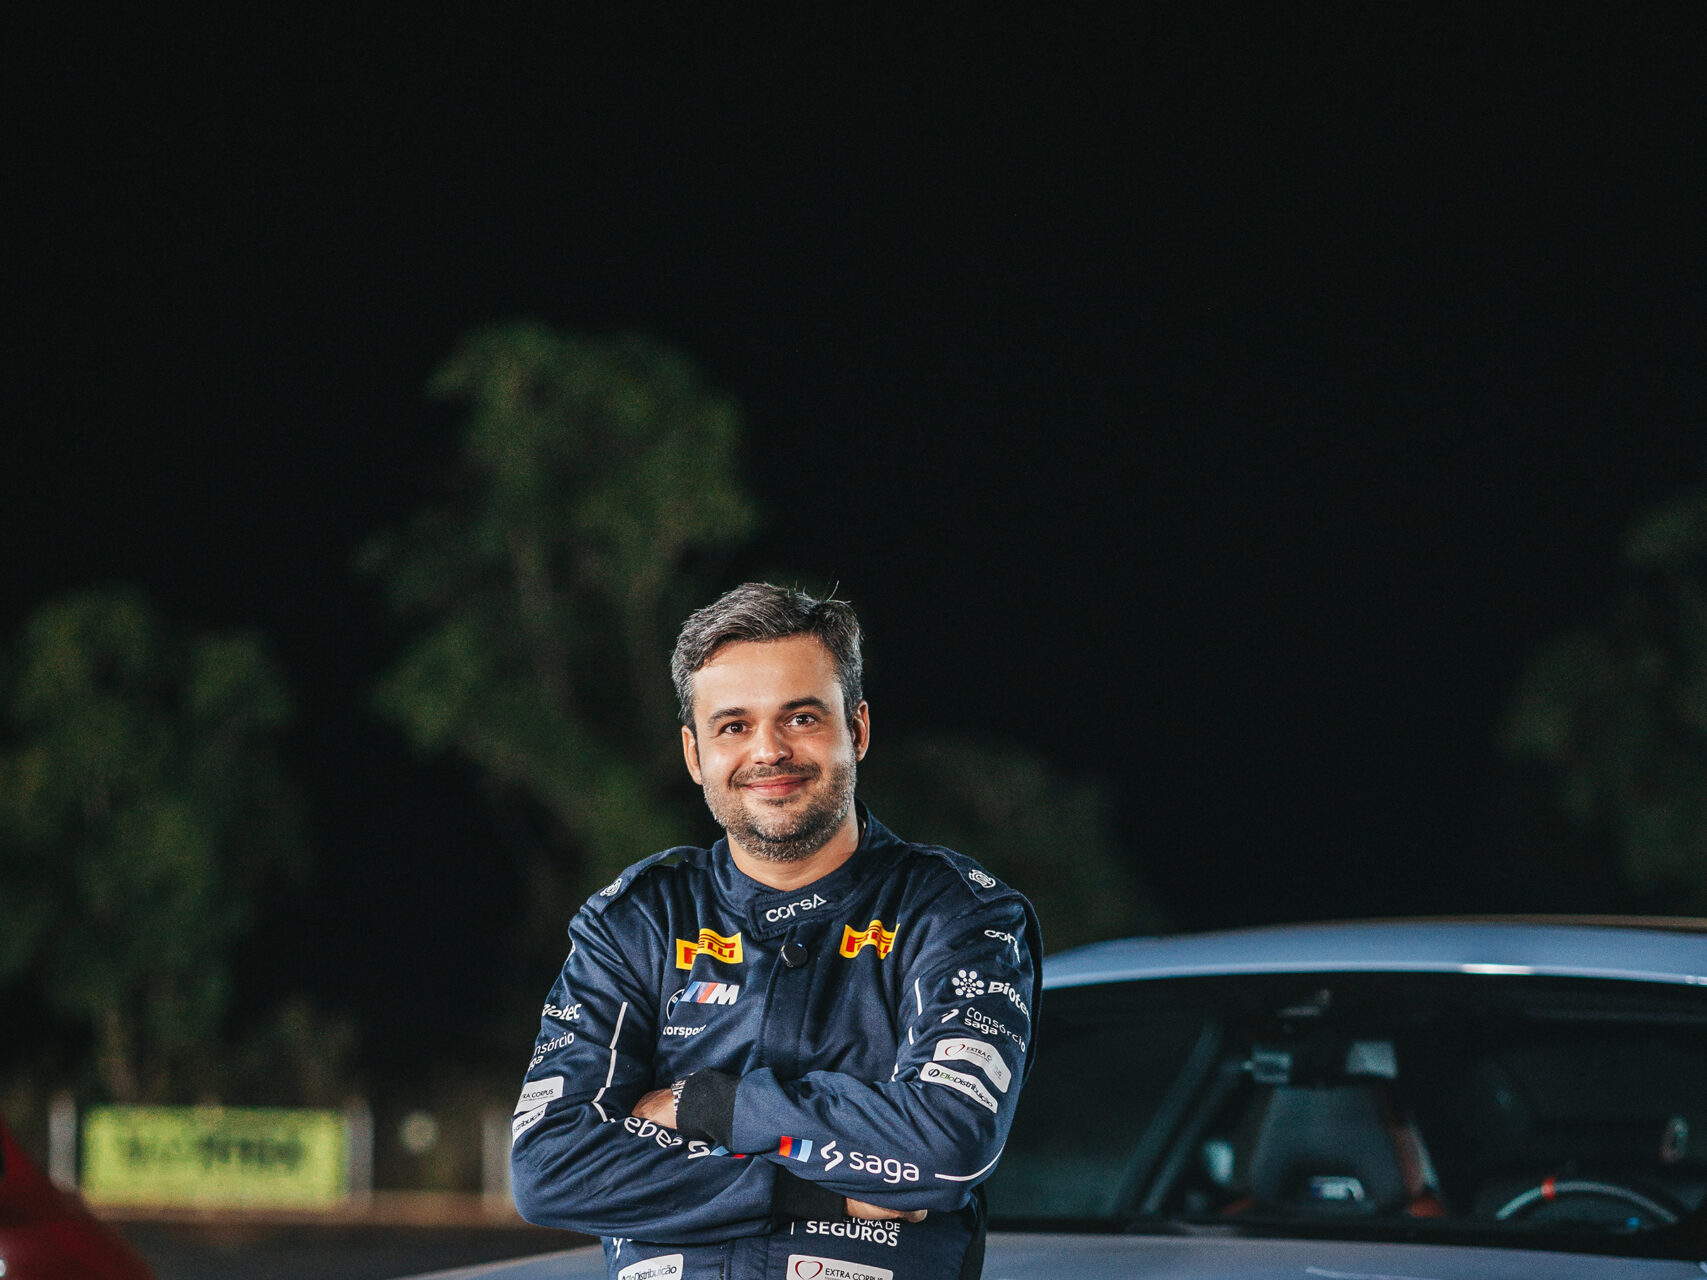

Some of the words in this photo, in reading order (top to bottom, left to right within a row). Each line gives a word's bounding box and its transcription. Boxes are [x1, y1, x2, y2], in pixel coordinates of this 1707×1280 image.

[964, 1018, 998, 1035] saga
[533, 1031, 575, 1057] nsórcio
[532, 1088, 554, 1099] CORPUS
[850, 1151, 920, 1184] saga
[806, 1220, 899, 1247] SEGUROS
[825, 1267, 851, 1280] EXTRA
